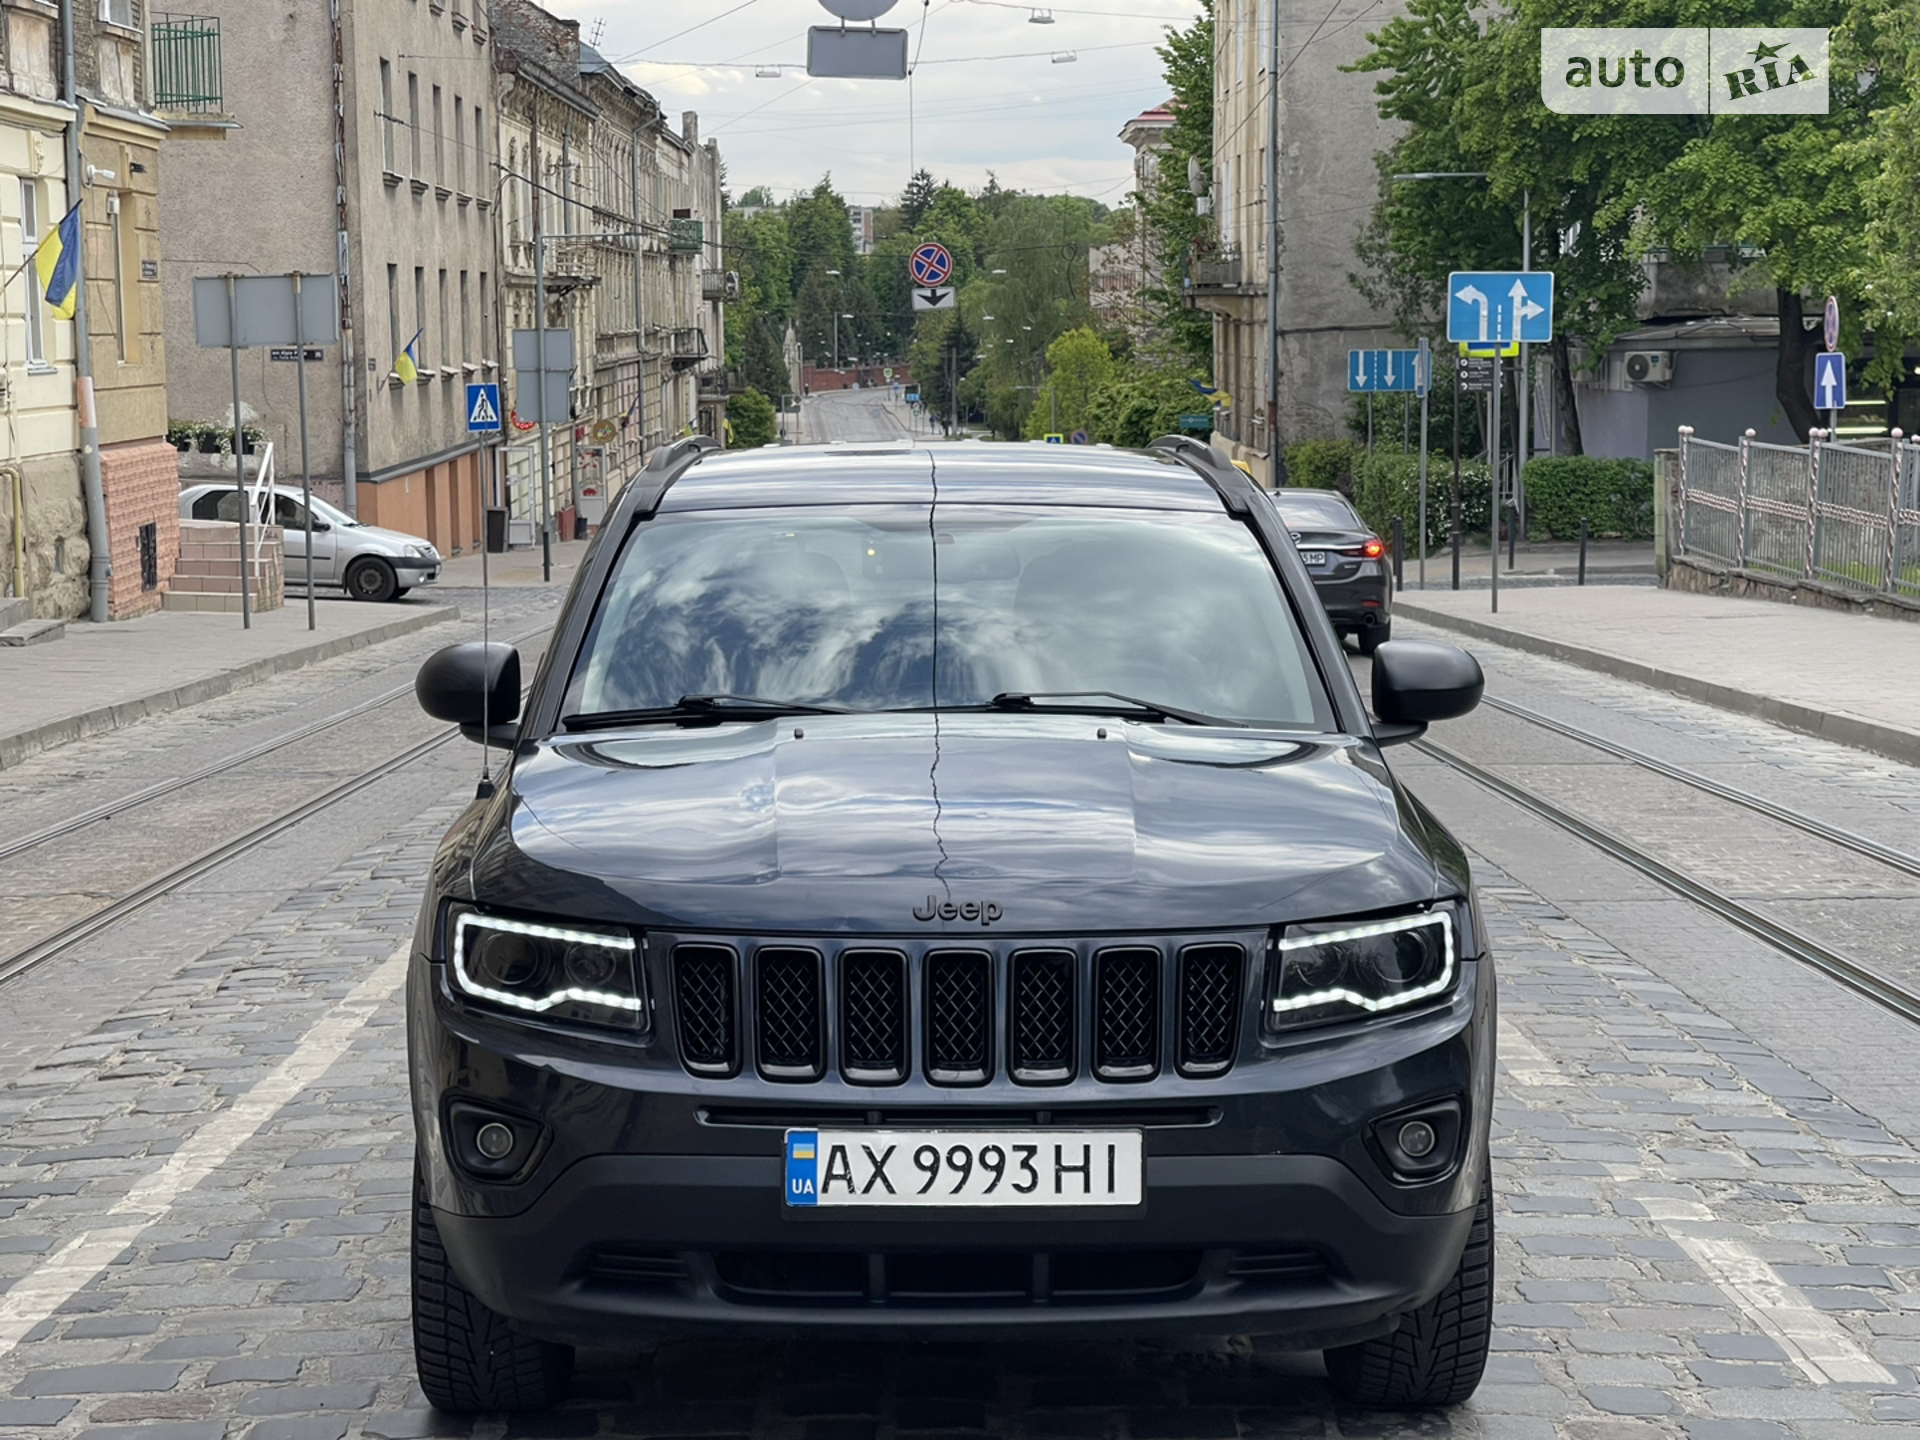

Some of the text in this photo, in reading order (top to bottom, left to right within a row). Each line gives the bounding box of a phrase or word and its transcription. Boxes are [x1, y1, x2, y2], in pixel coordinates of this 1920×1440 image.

[913, 895, 1003, 926] Jeep
[821, 1145, 1116, 1194] AX 9993 HI
[792, 1178, 815, 1194] UA
